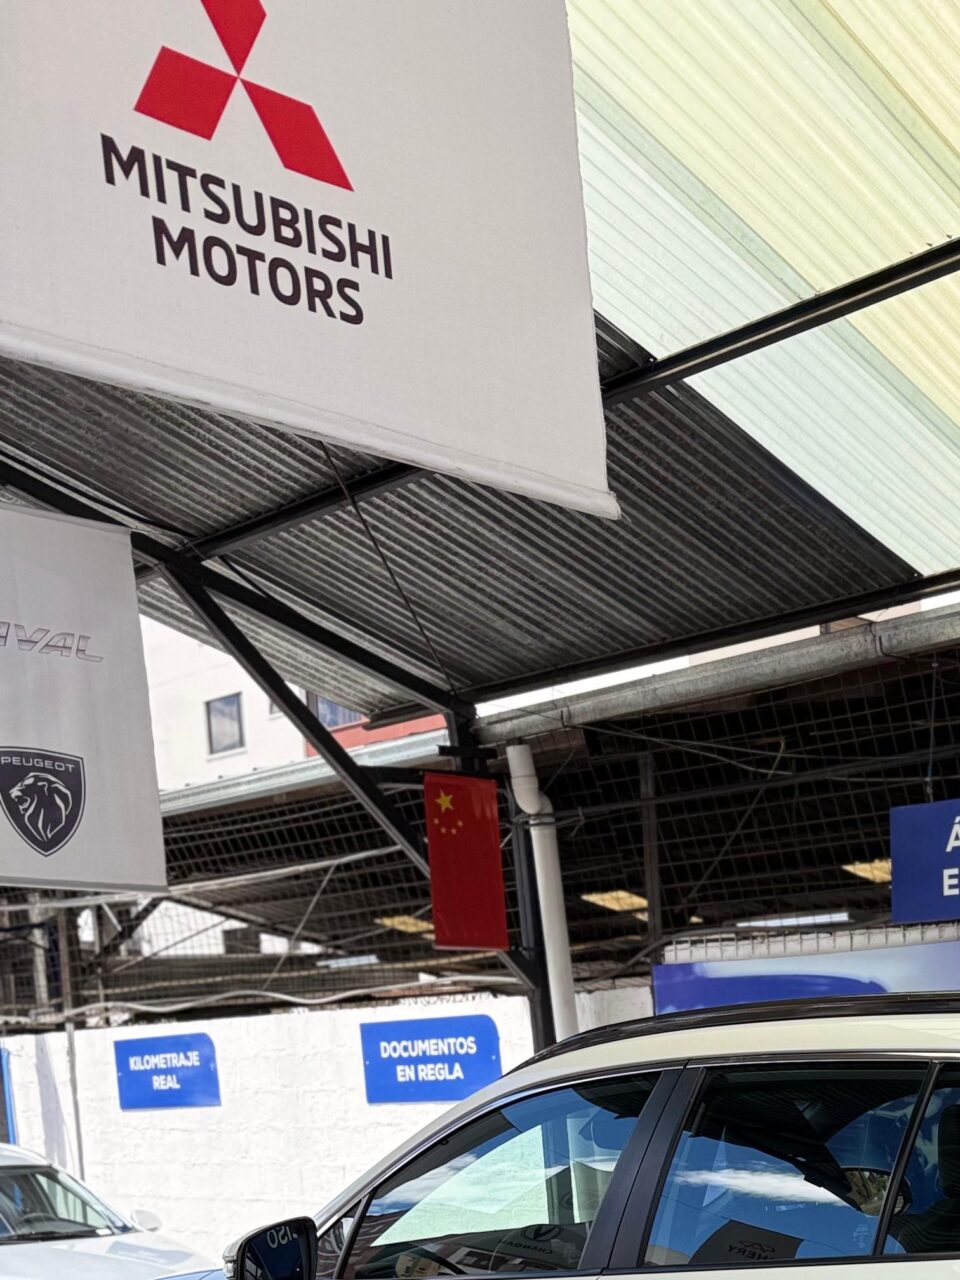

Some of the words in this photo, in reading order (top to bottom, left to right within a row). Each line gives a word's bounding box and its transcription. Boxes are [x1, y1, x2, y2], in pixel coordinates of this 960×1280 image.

[100, 133, 394, 280] MITSUBISHI
[151, 216, 364, 326] MOTORS
[0, 756, 76, 773] PEUGEOT
[380, 1036, 477, 1058] DOCUMENTOS
[129, 1051, 200, 1071] KILOMETRAJE
[396, 1064, 415, 1082] EN
[417, 1062, 464, 1081] REGLA
[152, 1074, 181, 1091] REAL
